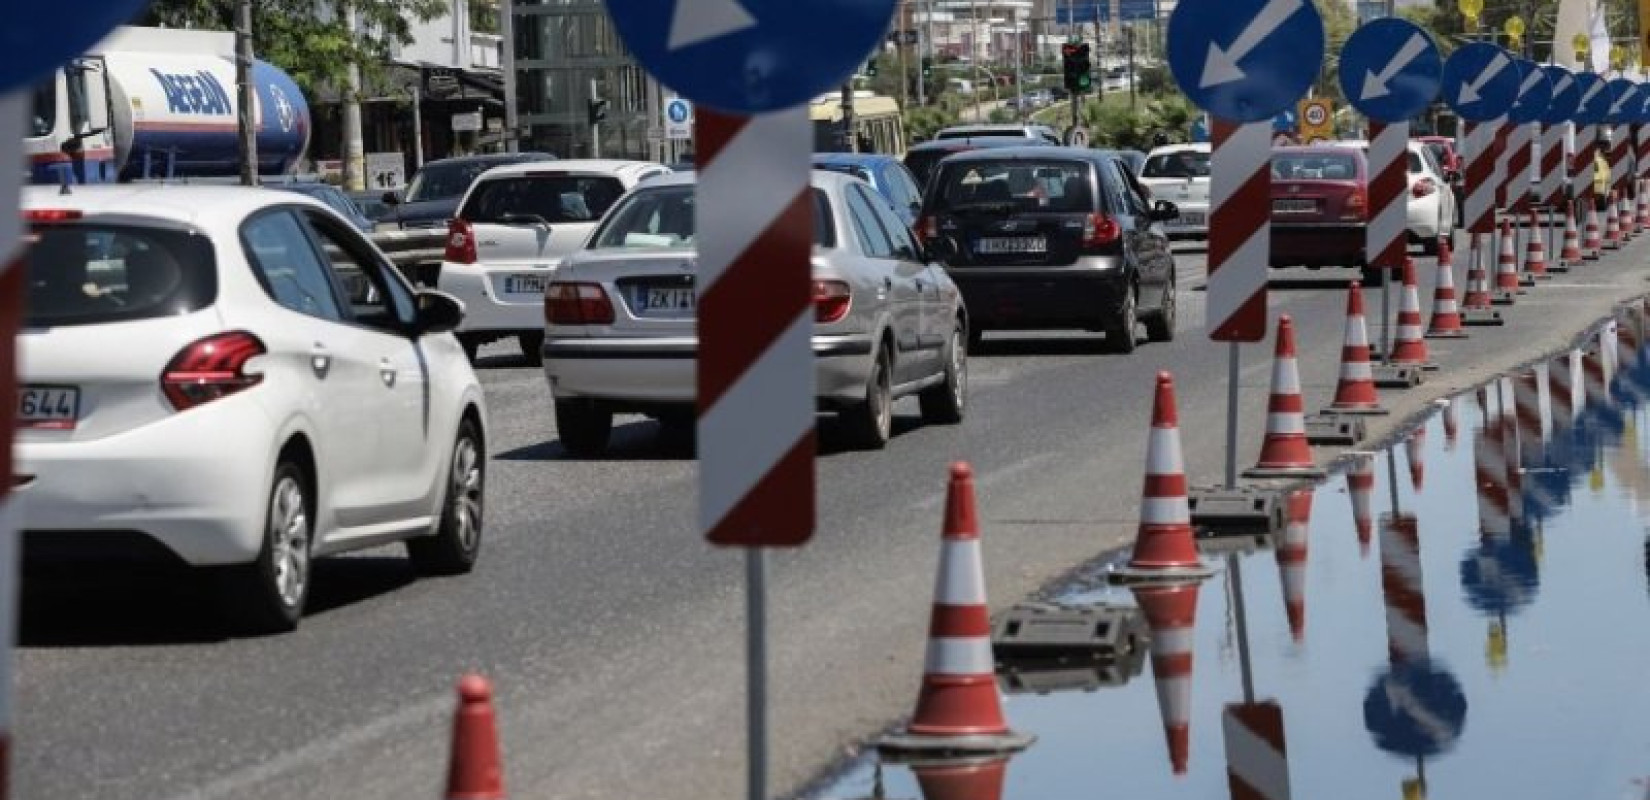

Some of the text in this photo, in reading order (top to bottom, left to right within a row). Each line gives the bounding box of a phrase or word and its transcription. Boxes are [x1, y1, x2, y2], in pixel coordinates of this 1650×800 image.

[149, 67, 231, 115] AEGEAN
[1309, 109, 1323, 120] 40
[22, 391, 70, 416] 644
